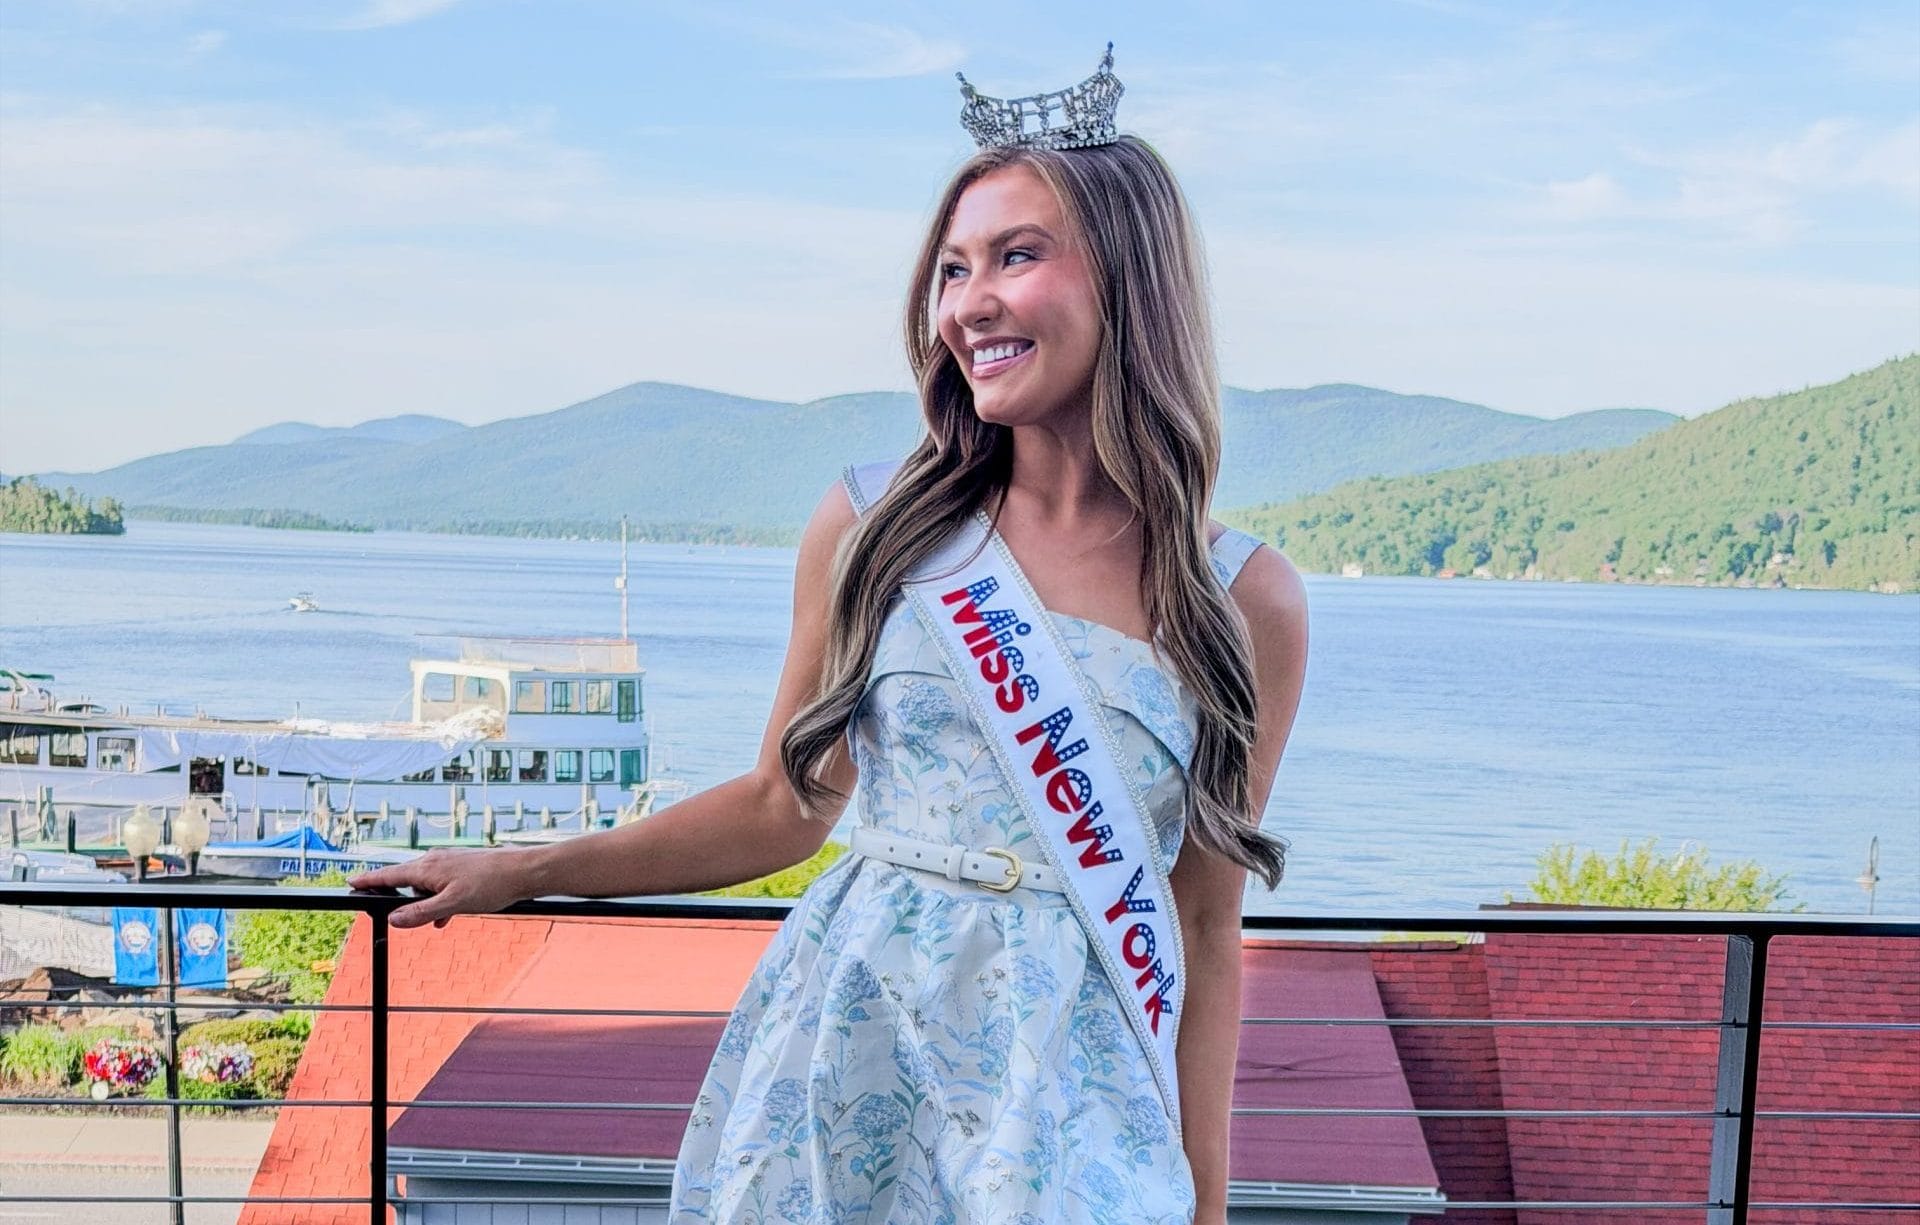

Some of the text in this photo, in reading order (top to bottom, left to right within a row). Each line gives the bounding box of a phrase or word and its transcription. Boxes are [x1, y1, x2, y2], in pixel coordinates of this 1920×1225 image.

[941, 575, 1176, 1037] Miss New York
